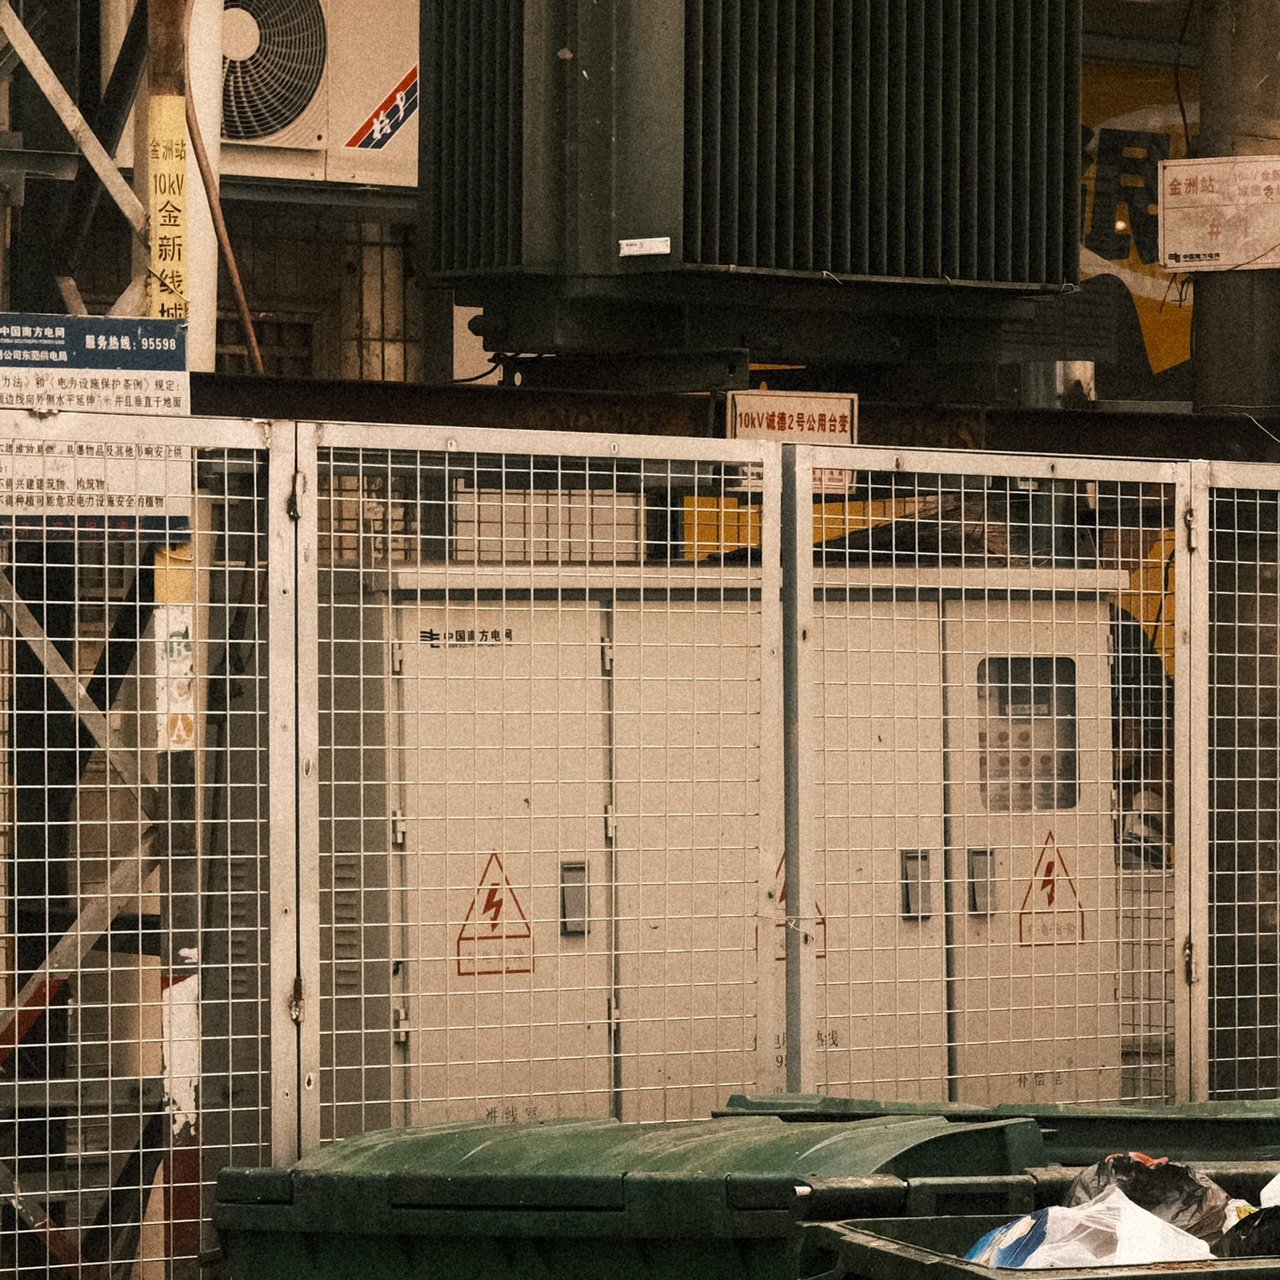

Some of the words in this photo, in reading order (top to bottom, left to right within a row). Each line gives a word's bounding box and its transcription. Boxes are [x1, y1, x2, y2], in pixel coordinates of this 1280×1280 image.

[149, 138, 187, 162] 金洲站
[152, 173, 185, 197] 10kV
[1168, 177, 1216, 197] 金洲站
[0, 325, 65, 339] 中国南方电网
[85, 334, 136, 351] 服务热线：
[141, 337, 177, 351] 95598
[738, 411, 849, 433] 10kV诚德2号公用台变
